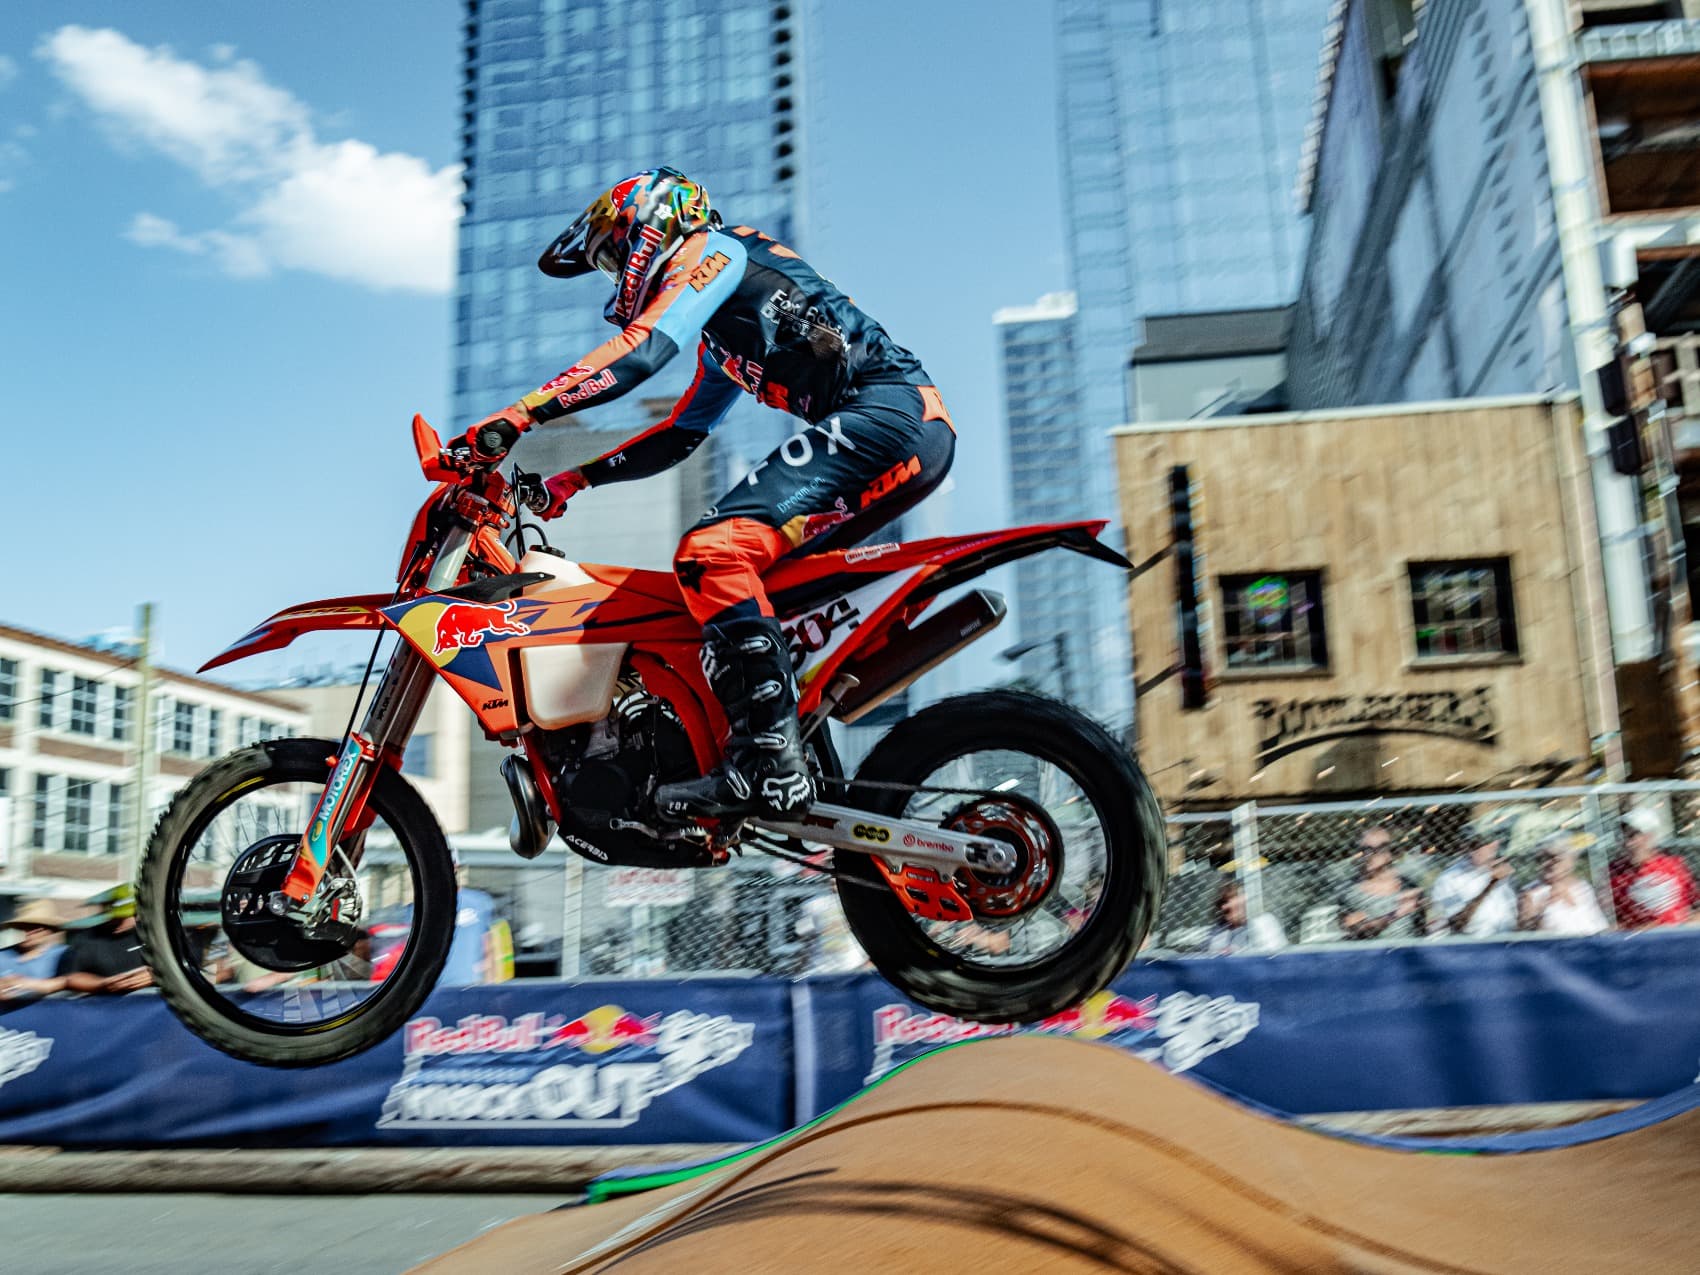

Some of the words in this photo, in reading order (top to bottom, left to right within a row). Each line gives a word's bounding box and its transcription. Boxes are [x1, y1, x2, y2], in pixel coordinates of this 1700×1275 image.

[628, 223, 667, 274] Bull
[688, 250, 732, 293] KTM
[557, 382, 590, 408] Red
[584, 368, 618, 396] Bull
[859, 454, 923, 509] KTM
[481, 698, 509, 711] KTM
[318, 751, 357, 821] MOTOREX
[668, 801, 689, 811] FOX
[565, 834, 609, 861] ACERBIS
[916, 838, 955, 854] brembo
